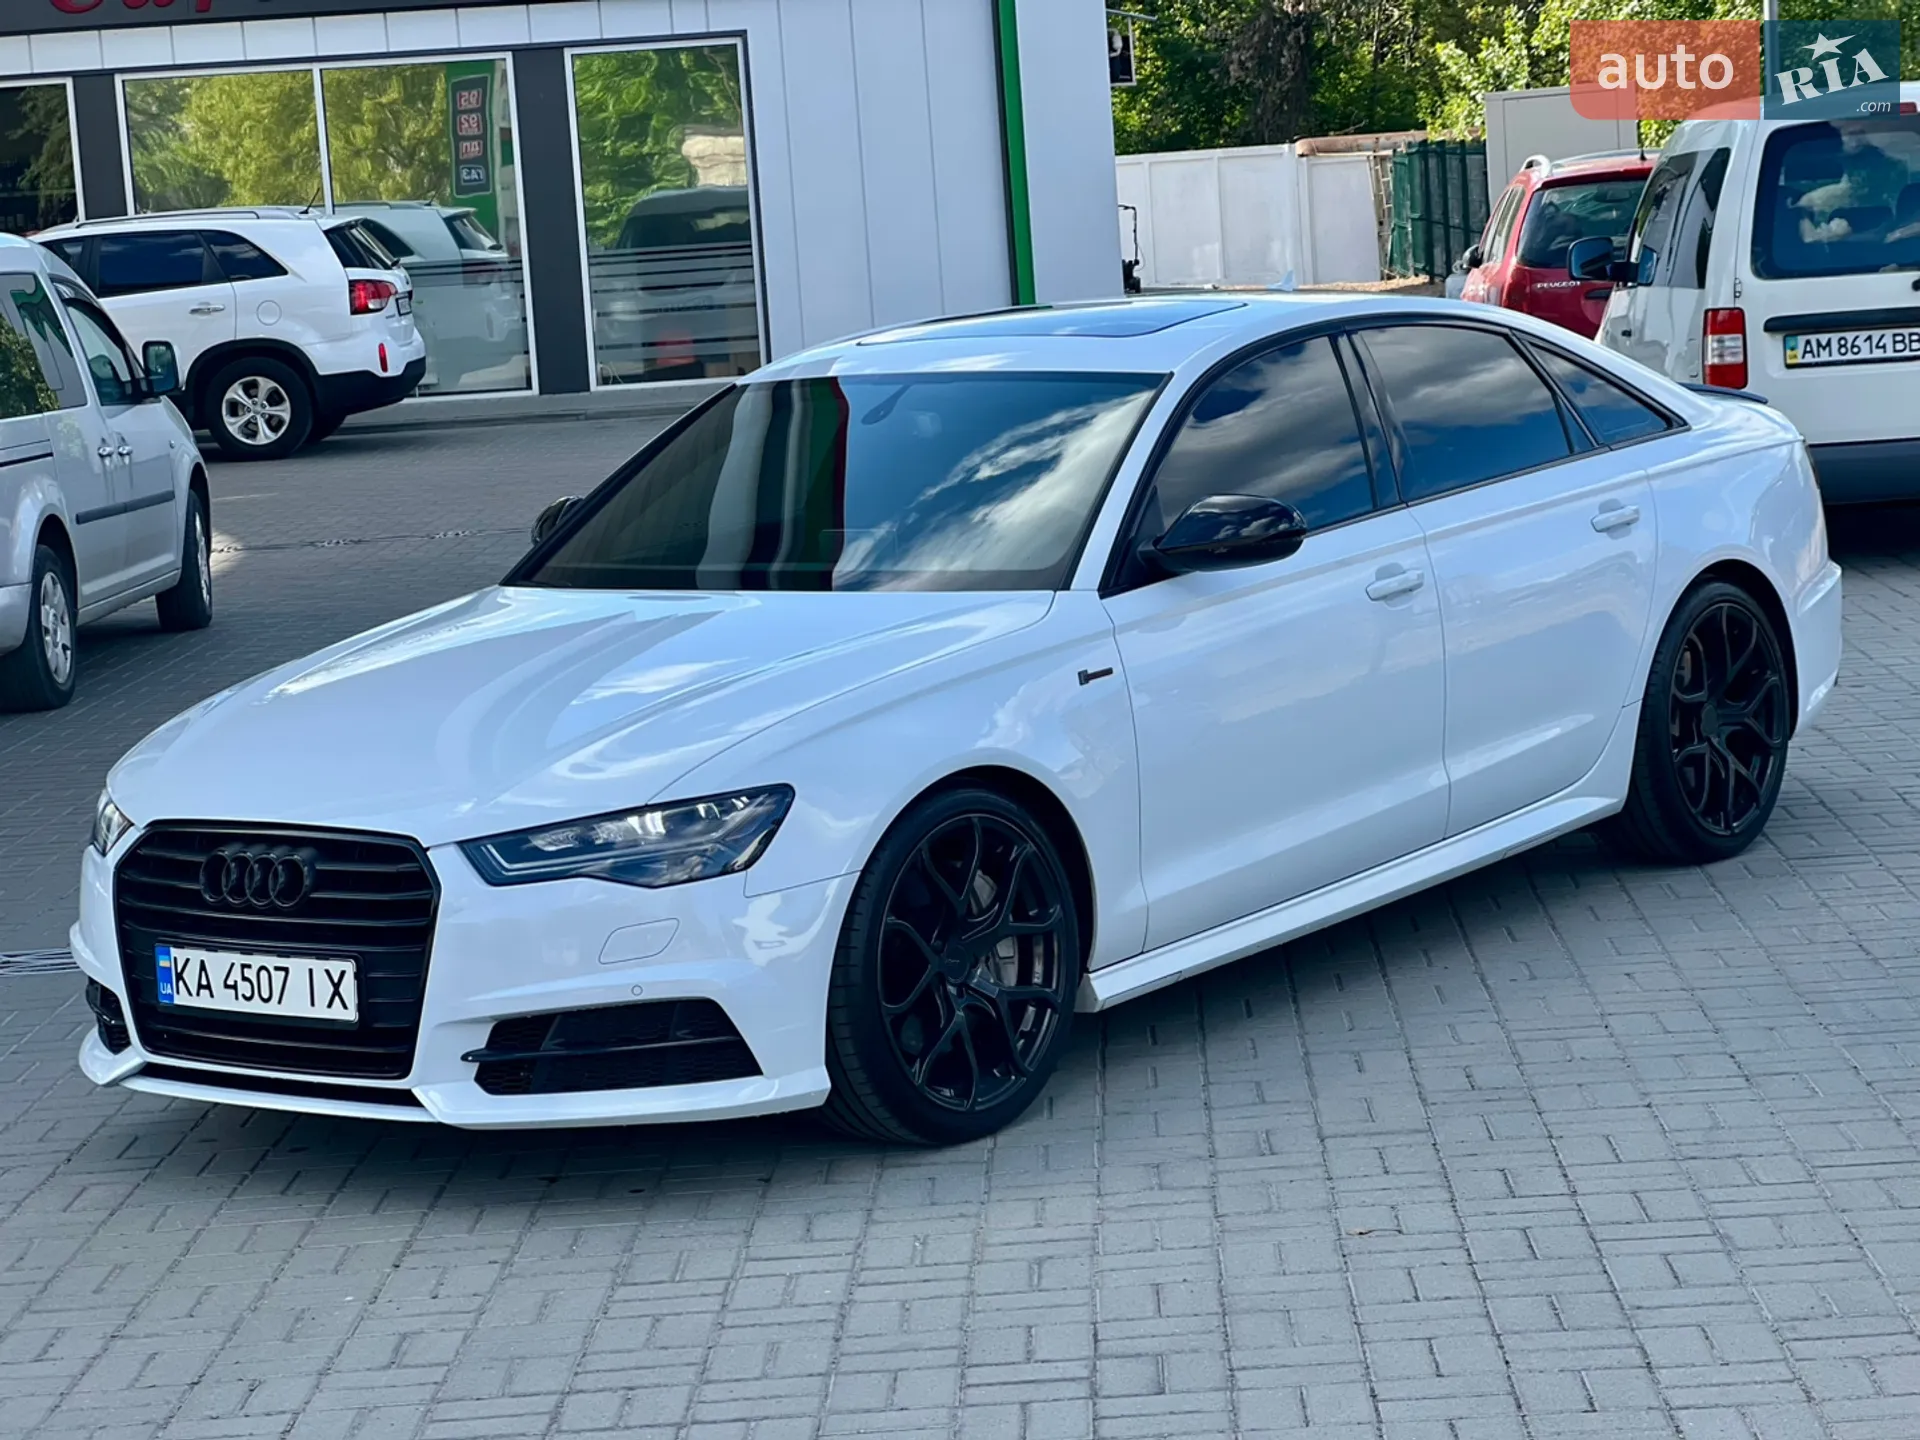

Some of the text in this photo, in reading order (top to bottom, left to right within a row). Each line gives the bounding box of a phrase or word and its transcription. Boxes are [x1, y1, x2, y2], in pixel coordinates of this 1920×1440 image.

[1801, 338, 1832, 359] AM
[1837, 334, 1887, 355] 8614
[160, 982, 173, 995] UA
[173, 956, 349, 1010] KA 4507 IX
